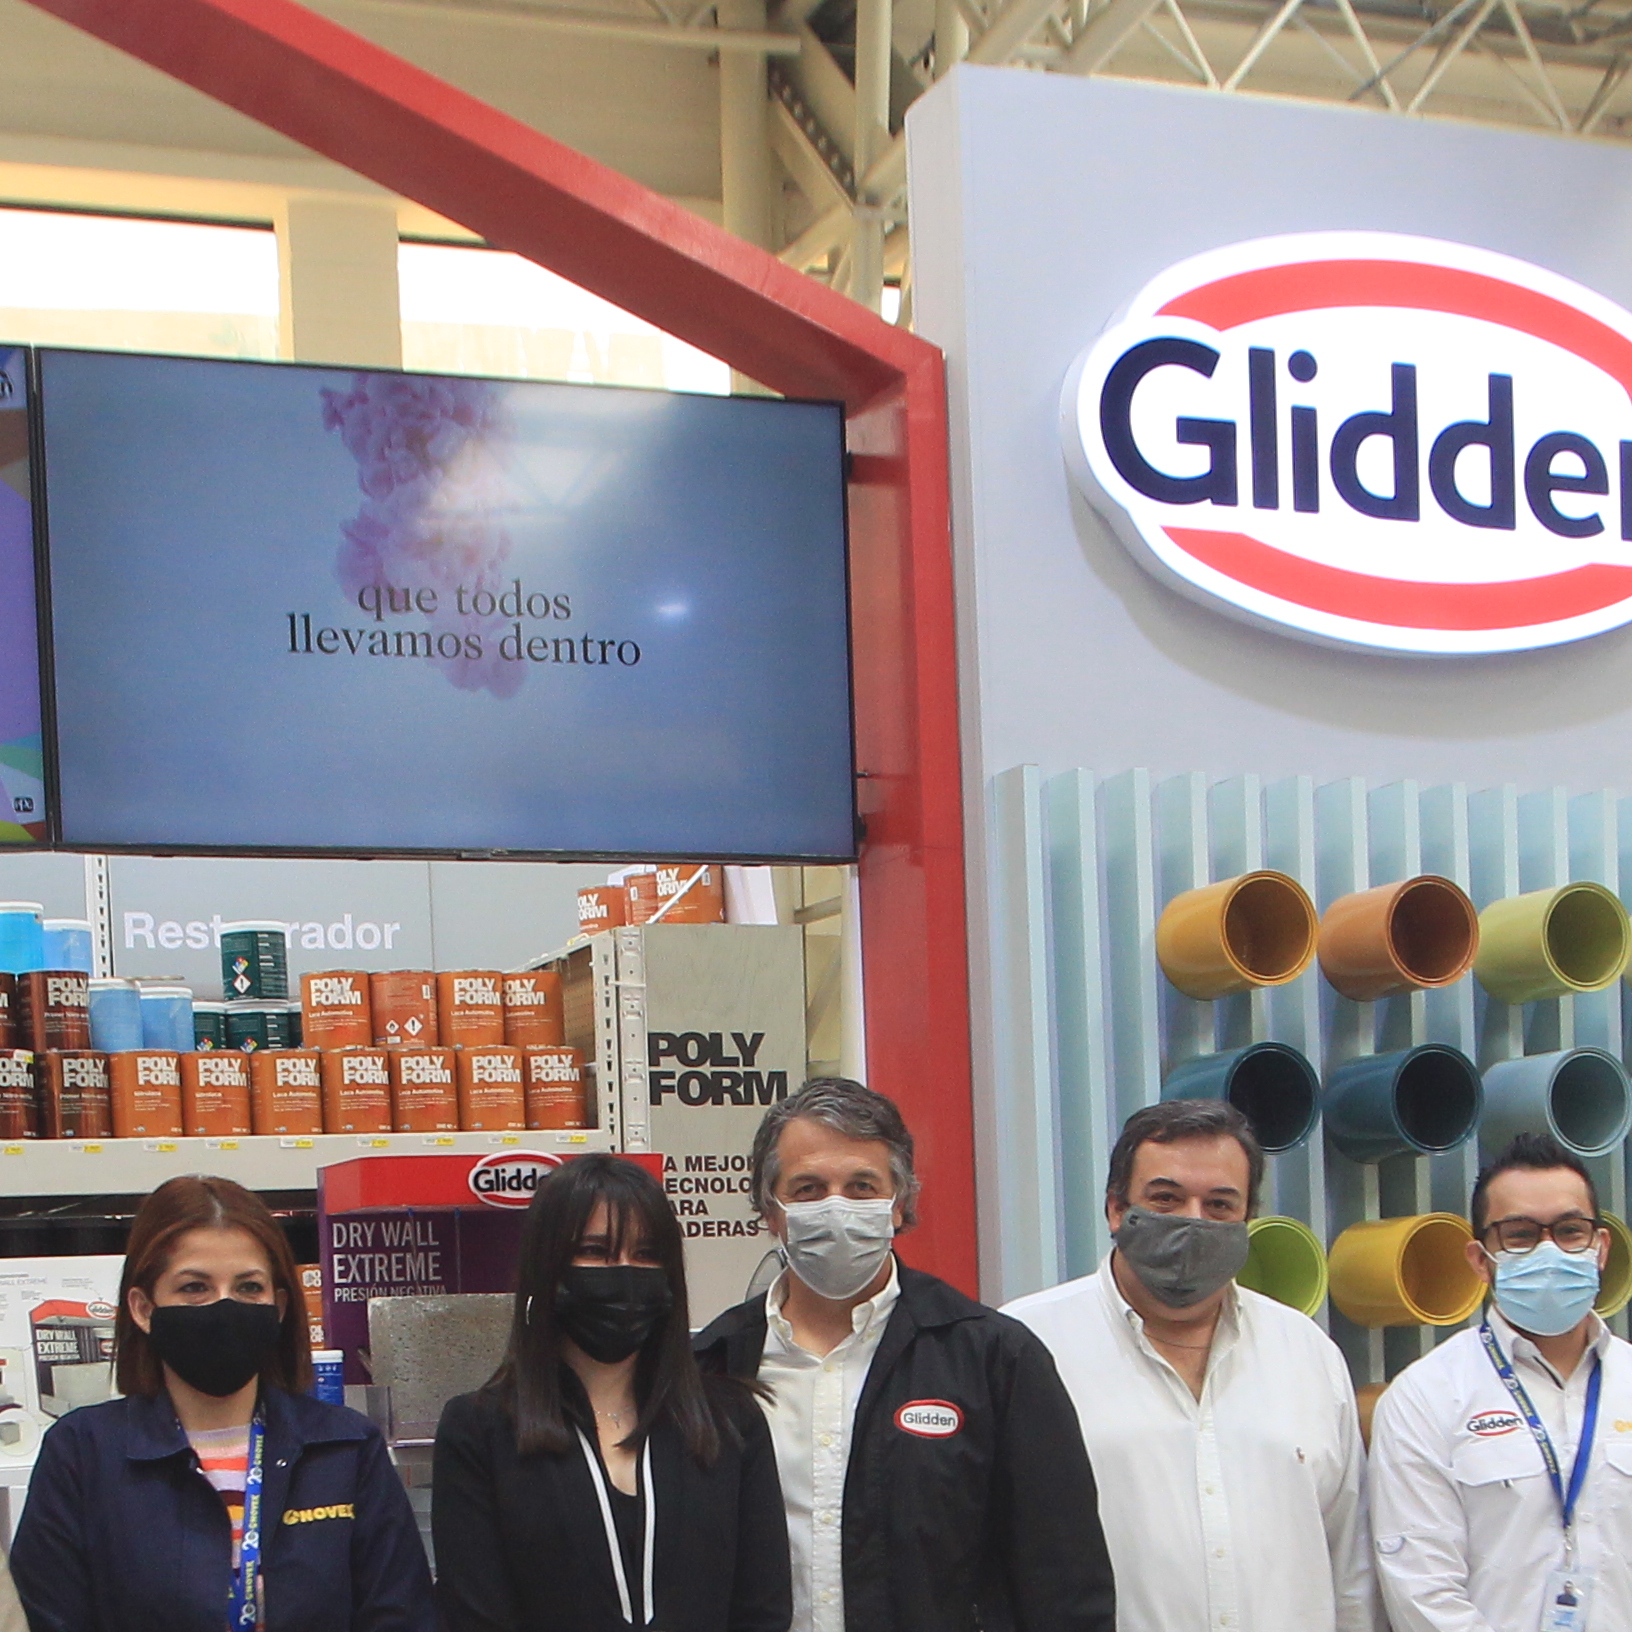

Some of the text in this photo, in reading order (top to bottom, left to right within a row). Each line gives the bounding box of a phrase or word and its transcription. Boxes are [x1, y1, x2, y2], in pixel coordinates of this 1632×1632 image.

[357, 579, 572, 621] que todos
[287, 612, 642, 667] llevamos dentro
[578, 893, 599, 909] OLY
[579, 904, 608, 920] ORM
[125, 913, 400, 951] Restrador
[310, 977, 353, 992] POLY
[454, 977, 495, 992] POLY
[504, 978, 536, 993] OLY
[49, 992, 88, 1007] FOR
[311, 990, 362, 1006] FORM
[455, 991, 501, 1005] FORM
[505, 991, 546, 1006] ORM
[649, 1032, 765, 1067] POLY
[62, 1057, 107, 1073] POLY
[137, 1057, 178, 1072] POLY
[197, 1057, 241, 1072] POLY
[275, 1058, 317, 1072] POLY
[342, 1057, 384, 1071] POLY
[400, 1055, 444, 1070] POLY
[472, 1055, 515, 1069] POLY
[530, 1054, 573, 1069] POLY
[63, 1072, 110, 1087] FORM
[199, 1071, 247, 1086] FORM
[343, 1070, 389, 1084] FORM
[401, 1069, 451, 1084] FORM
[473, 1068, 521, 1083] FORM
[531, 1068, 580, 1082] FORM
[649, 1070, 788, 1106] FORM
[473, 1168, 548, 1193] Glidd
[333, 1220, 439, 1249] DRY WALL
[333, 1252, 442, 1284] EXTREME
[334, 1283, 389, 1303] PRESIÓN
[37, 1341, 78, 1354] EXTREME
[903, 1412, 956, 1427] Glidden
[1467, 1413, 1524, 1432] Glidden
[299, 1503, 354, 1523] NOVEX
